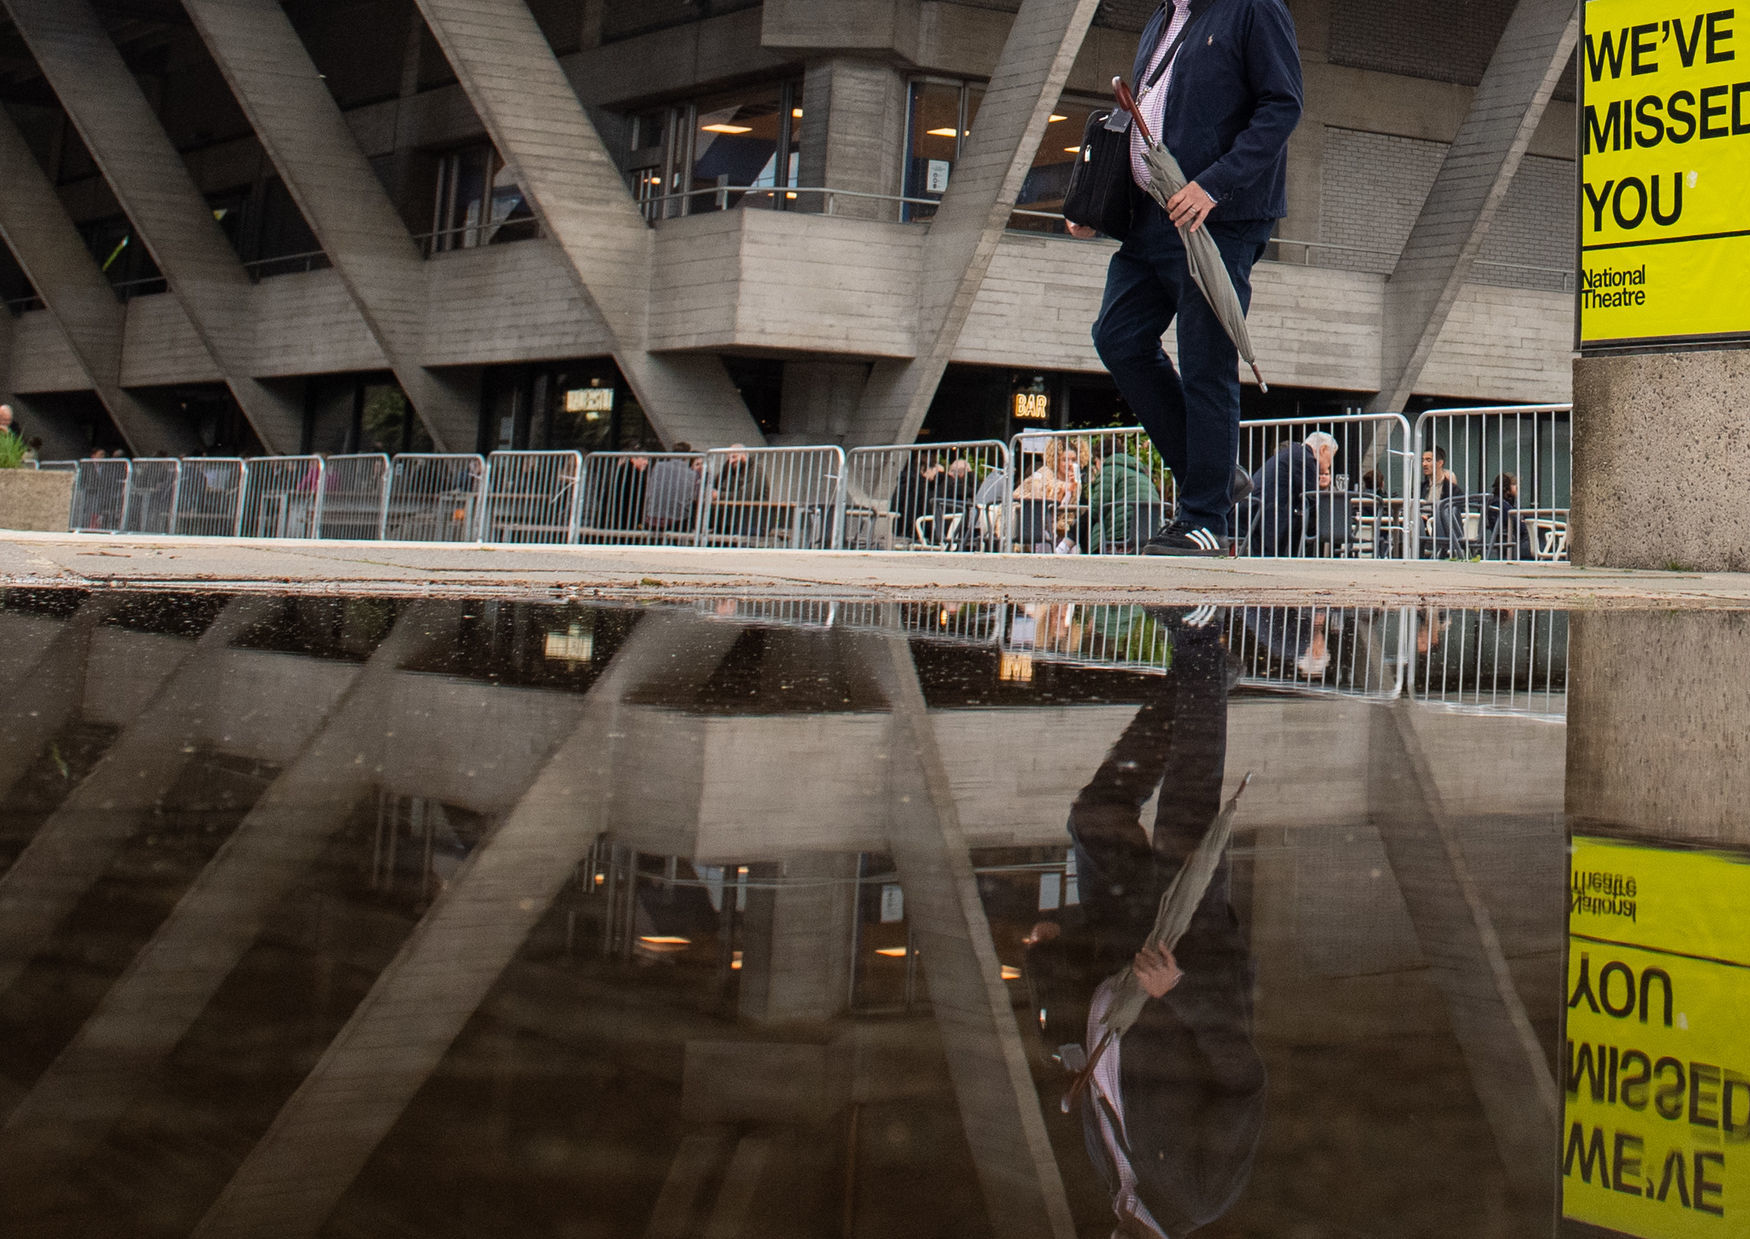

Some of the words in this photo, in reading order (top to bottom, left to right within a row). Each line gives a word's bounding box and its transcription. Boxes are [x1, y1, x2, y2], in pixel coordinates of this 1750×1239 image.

[1585, 9, 1736, 82] WE’VE
[1584, 172, 1683, 232] YOU
[1582, 265, 1646, 289] National
[1581, 289, 1646, 309] Theatre
[1015, 393, 1047, 418] BAR
